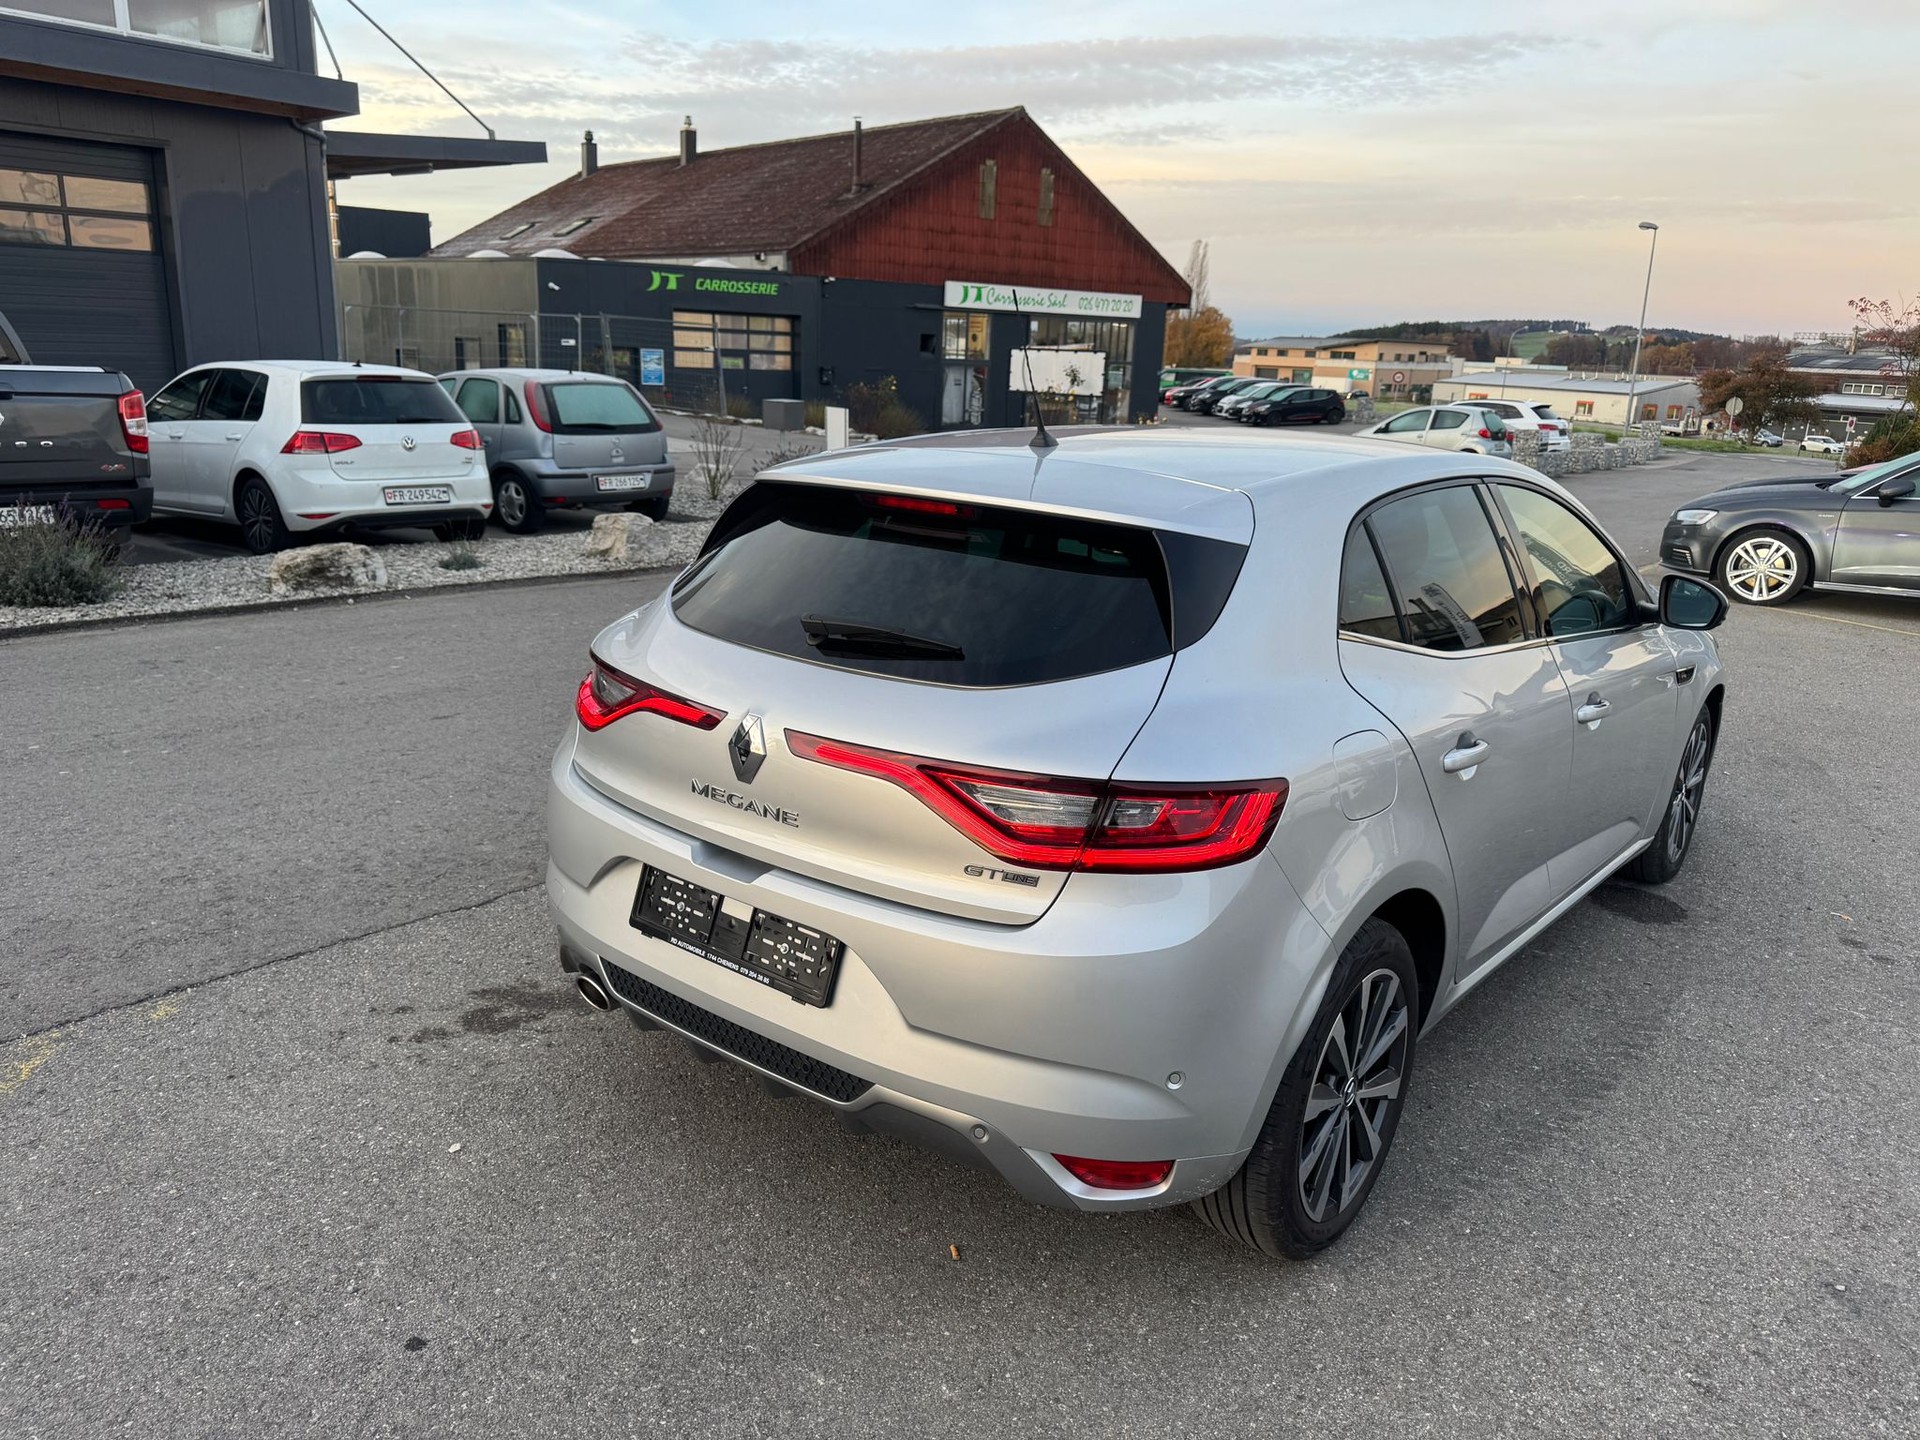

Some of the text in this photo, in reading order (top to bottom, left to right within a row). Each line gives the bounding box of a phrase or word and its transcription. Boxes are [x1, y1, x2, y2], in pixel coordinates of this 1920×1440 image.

[647, 271, 779, 296] JT CARROSSERIE
[960, 285, 987, 304] JT
[1111, 299, 1122, 312] 20
[1123, 300, 1134, 313] 20
[691, 778, 799, 828] MEGANE
[963, 864, 1038, 886] GT LINE
[677, 940, 706, 957] AUTOMOBILE
